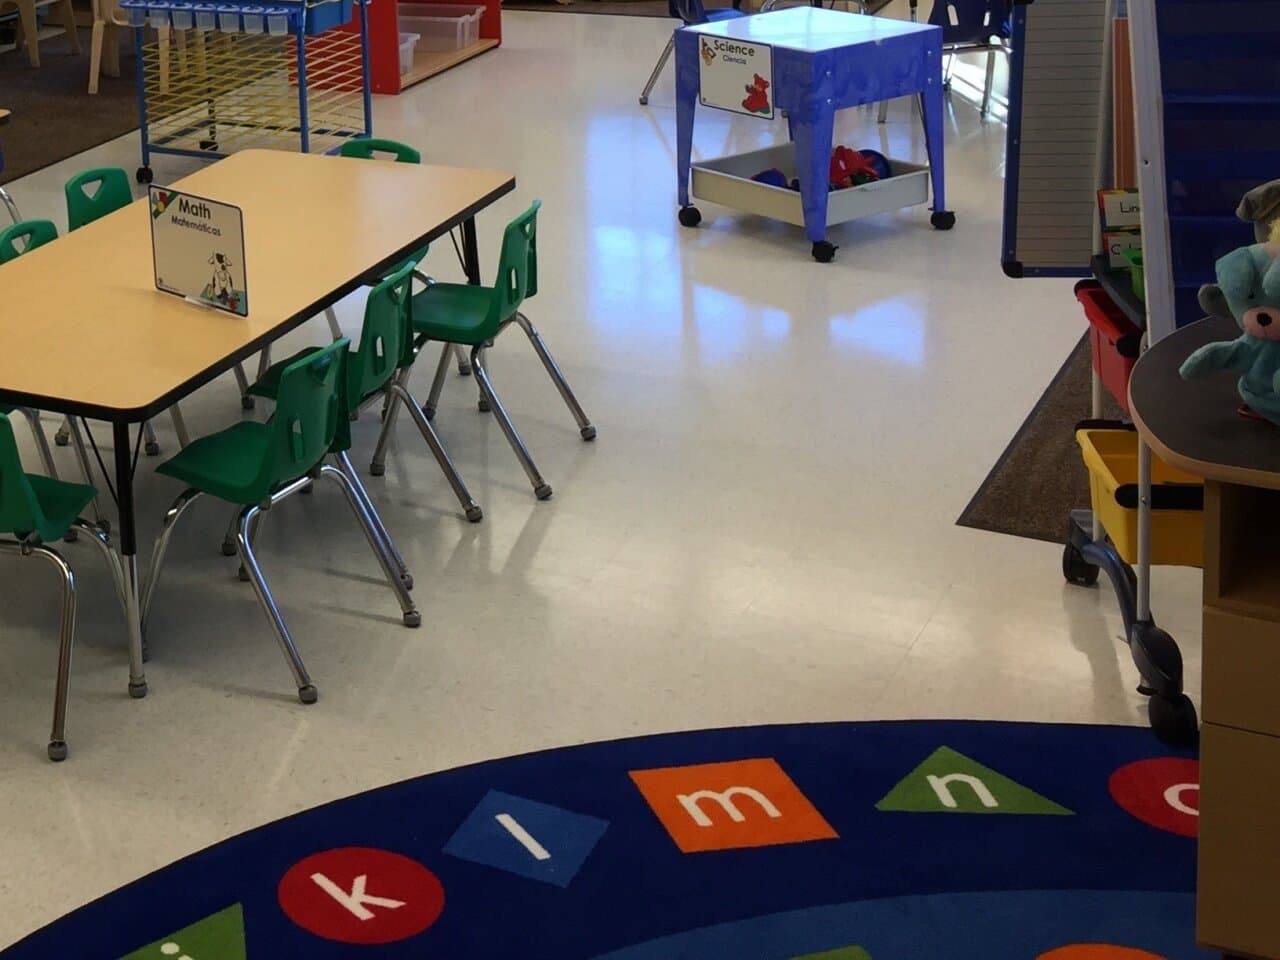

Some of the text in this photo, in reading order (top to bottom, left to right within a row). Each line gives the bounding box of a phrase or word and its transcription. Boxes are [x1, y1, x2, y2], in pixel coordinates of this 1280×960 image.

[714, 40, 755, 56] Science
[179, 198, 211, 219] Math
[1120, 202, 1140, 213] Lin
[310, 852, 407, 921] k
[676, 786, 783, 828] m
[926, 773, 999, 808] n
